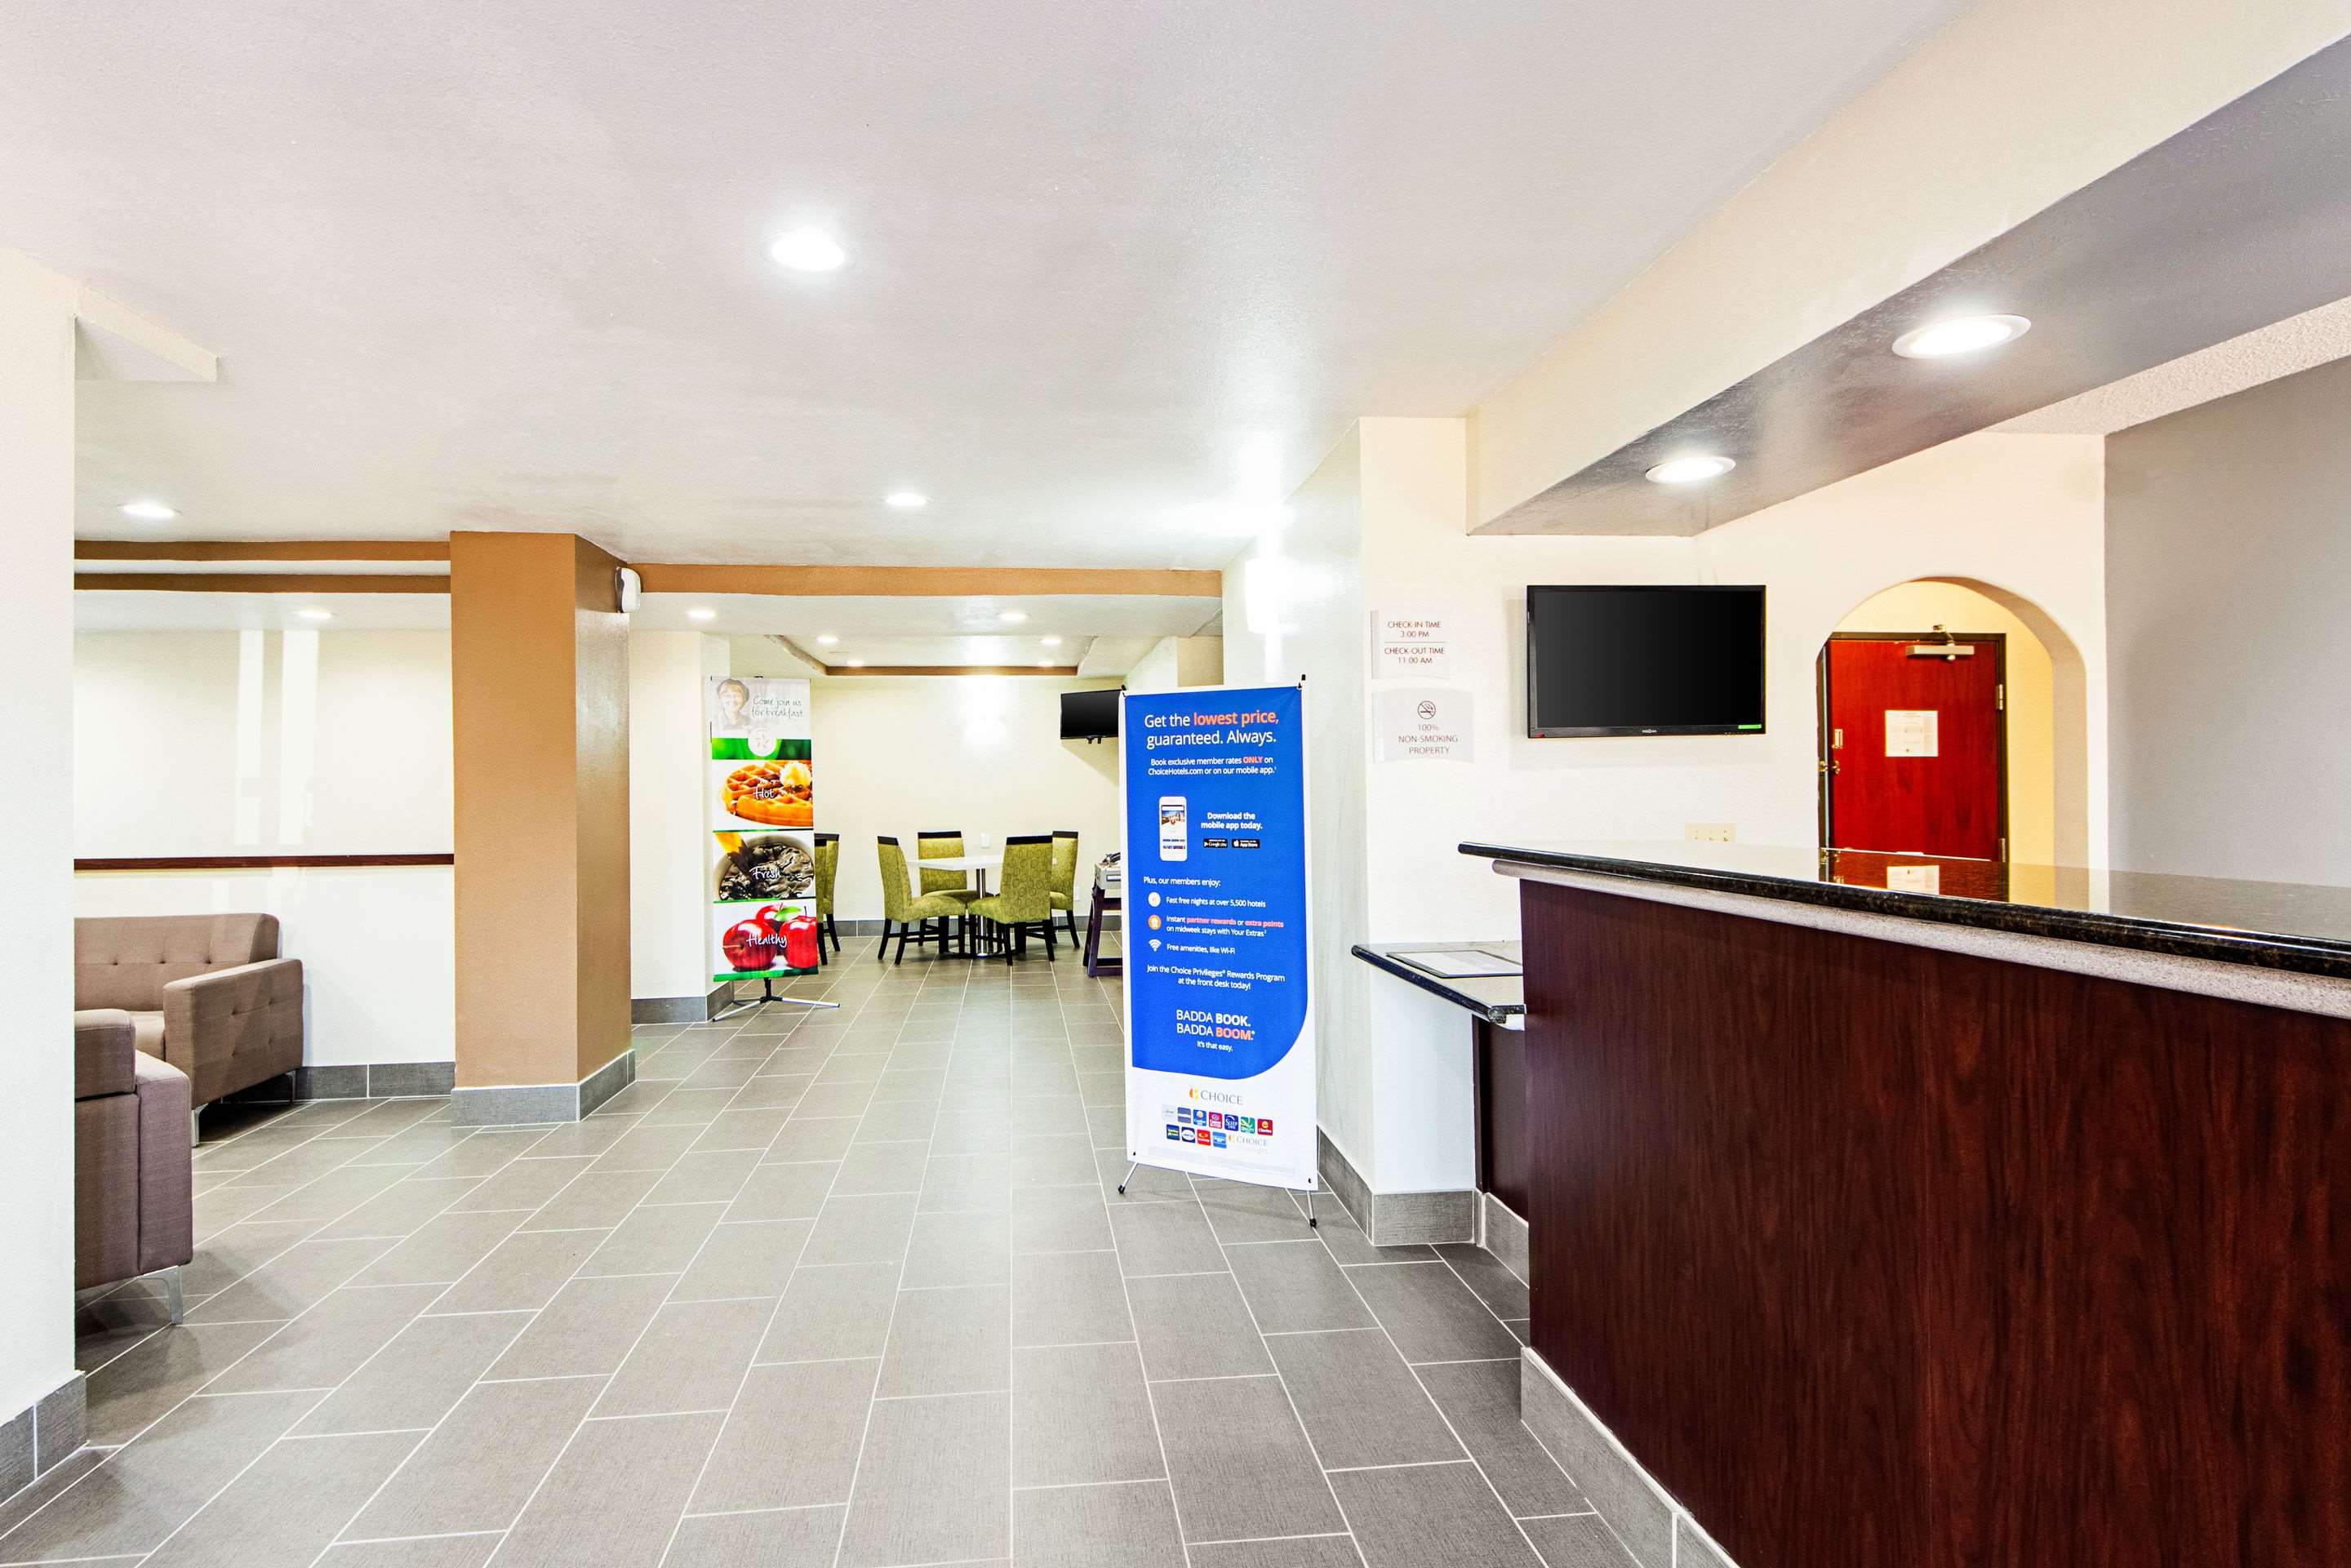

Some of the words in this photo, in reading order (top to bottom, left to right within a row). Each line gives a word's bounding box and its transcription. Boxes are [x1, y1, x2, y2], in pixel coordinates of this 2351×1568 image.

[753, 695, 774, 705] Come
[752, 705, 764, 718] for
[1144, 715, 1167, 728] Get
[1170, 713, 1190, 726] the
[1193, 712, 1238, 726] lowest
[1241, 709, 1280, 727] price,
[1417, 723, 1439, 731] 100%
[1147, 730, 1224, 749] guaranteed.
[1226, 730, 1277, 747] Always.
[1398, 735, 1459, 744] NON-SMOKING
[1409, 746, 1451, 755] PROPERTY
[1168, 757, 1195, 766] exclusive
[1197, 757, 1224, 766] member
[1243, 756, 1264, 764] ONLY
[1148, 767, 1203, 775] ChoiceHotels.com
[754, 785, 776, 800] Hot
[1201, 821, 1224, 829] mobile
[1226, 823, 1239, 831] app
[1241, 821, 1263, 831] today.
[749, 867, 780, 880] Fresh
[1143, 876, 1158, 885] Plus,
[1171, 877, 1201, 886] members
[1202, 878, 1221, 888] enjoy:
[1190, 898, 1208, 906] nights
[1247, 899, 1266, 908] hotels
[1176, 926, 1200, 934] midweek
[1202, 927, 1216, 935] stays
[746, 934, 788, 948] Healthy
[1167, 944, 1179, 952] Free
[1180, 945, 1208, 953] amenities,
[1220, 947, 1236, 955] Wi-Fi
[1146, 965, 1159, 973] Join
[1171, 966, 1192, 975] Choice
[1227, 971, 1255, 979] Rewards
[1255, 972, 1285, 983] Program
[1185, 978, 1196, 986] the
[1197, 979, 1213, 987] front
[1215, 979, 1229, 988] desk
[1230, 981, 1251, 991] today!
[1176, 1009, 1213, 1024] BADDA
[1215, 1013, 1251, 1027] BOOK.
[1177, 1024, 1213, 1037] BADDA
[1206, 1042, 1218, 1050] that
[1218, 1044, 1233, 1052] easy.
[1200, 1090, 1244, 1105] CHOICE
